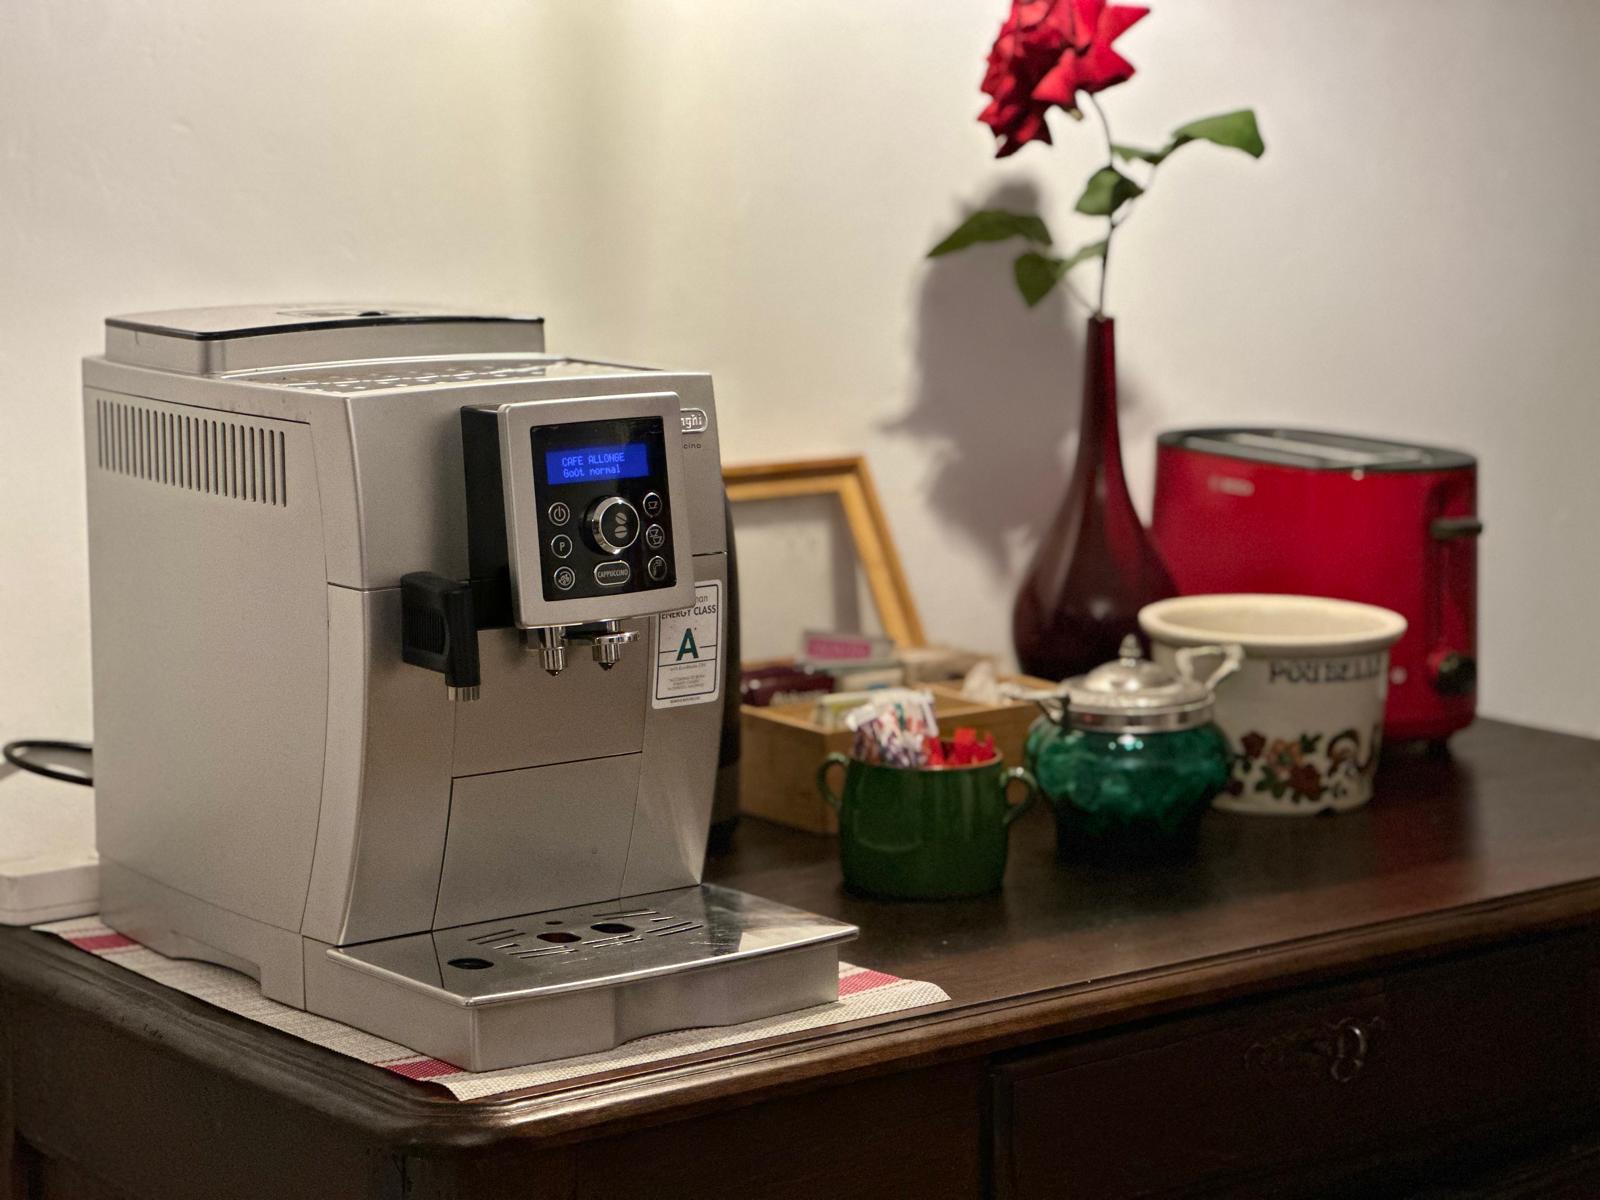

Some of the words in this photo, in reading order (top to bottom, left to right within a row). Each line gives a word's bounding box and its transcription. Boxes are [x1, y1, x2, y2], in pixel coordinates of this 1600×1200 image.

[683, 442, 702, 450] cino
[561, 455, 585, 467] CAFE
[589, 463, 621, 477] normal
[559, 541, 566, 552] P
[597, 568, 629, 579] CAPPUCCINO
[661, 609, 692, 620] ENERGY
[693, 604, 717, 616] CLASS
[676, 627, 699, 661] A
